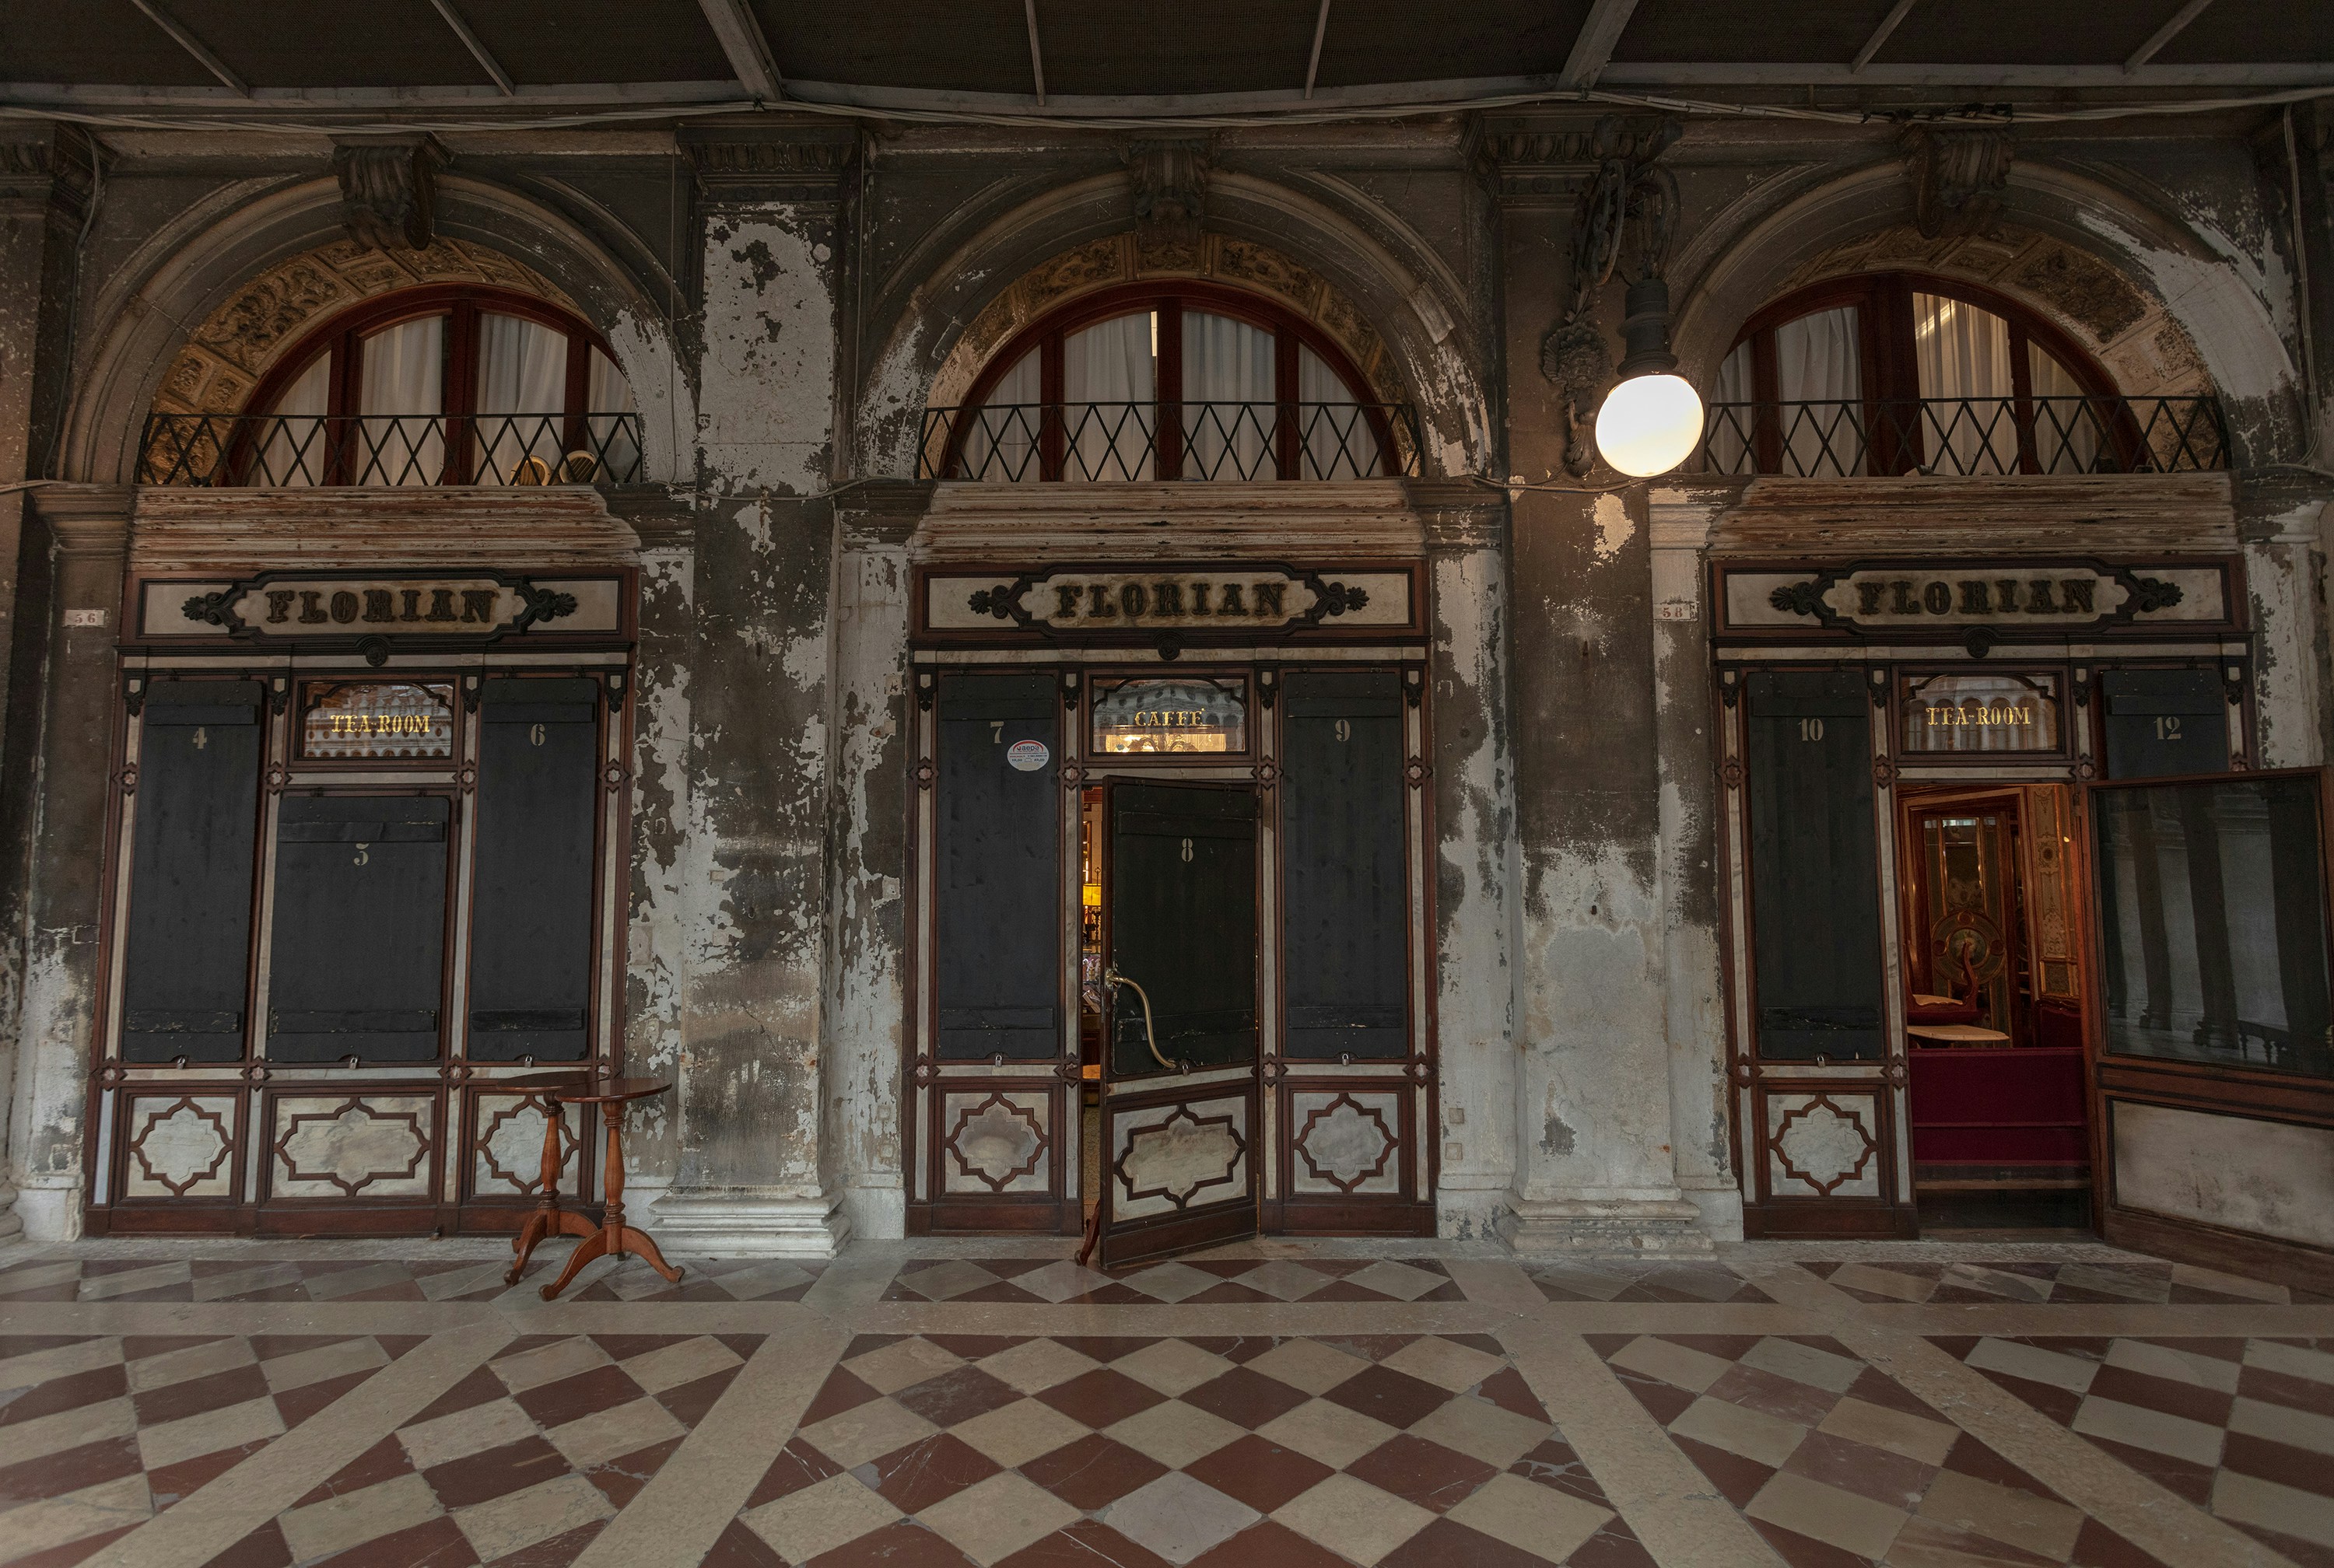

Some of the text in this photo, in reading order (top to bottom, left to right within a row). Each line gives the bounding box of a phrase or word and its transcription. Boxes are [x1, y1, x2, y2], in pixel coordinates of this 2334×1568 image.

[265, 589, 499, 624] FLORIAN
[1055, 583, 1287, 618] FLORIAN
[1855, 579, 2096, 615] FLORIAN
[75, 613, 96, 624] 56
[1663, 607, 1683, 618] 58
[330, 715, 431, 733] TEA-ROOM
[1925, 706, 2031, 726] TEA-ROOM
[192, 726, 208, 749] 4
[530, 723, 545, 746] 6
[990, 721, 1004, 744] 7
[1334, 719, 1351, 742] 9
[1798, 718, 1824, 741] 10
[2153, 716, 2182, 740] 12
[353, 843, 370, 866] 5
[1181, 838, 1194, 863] 8
